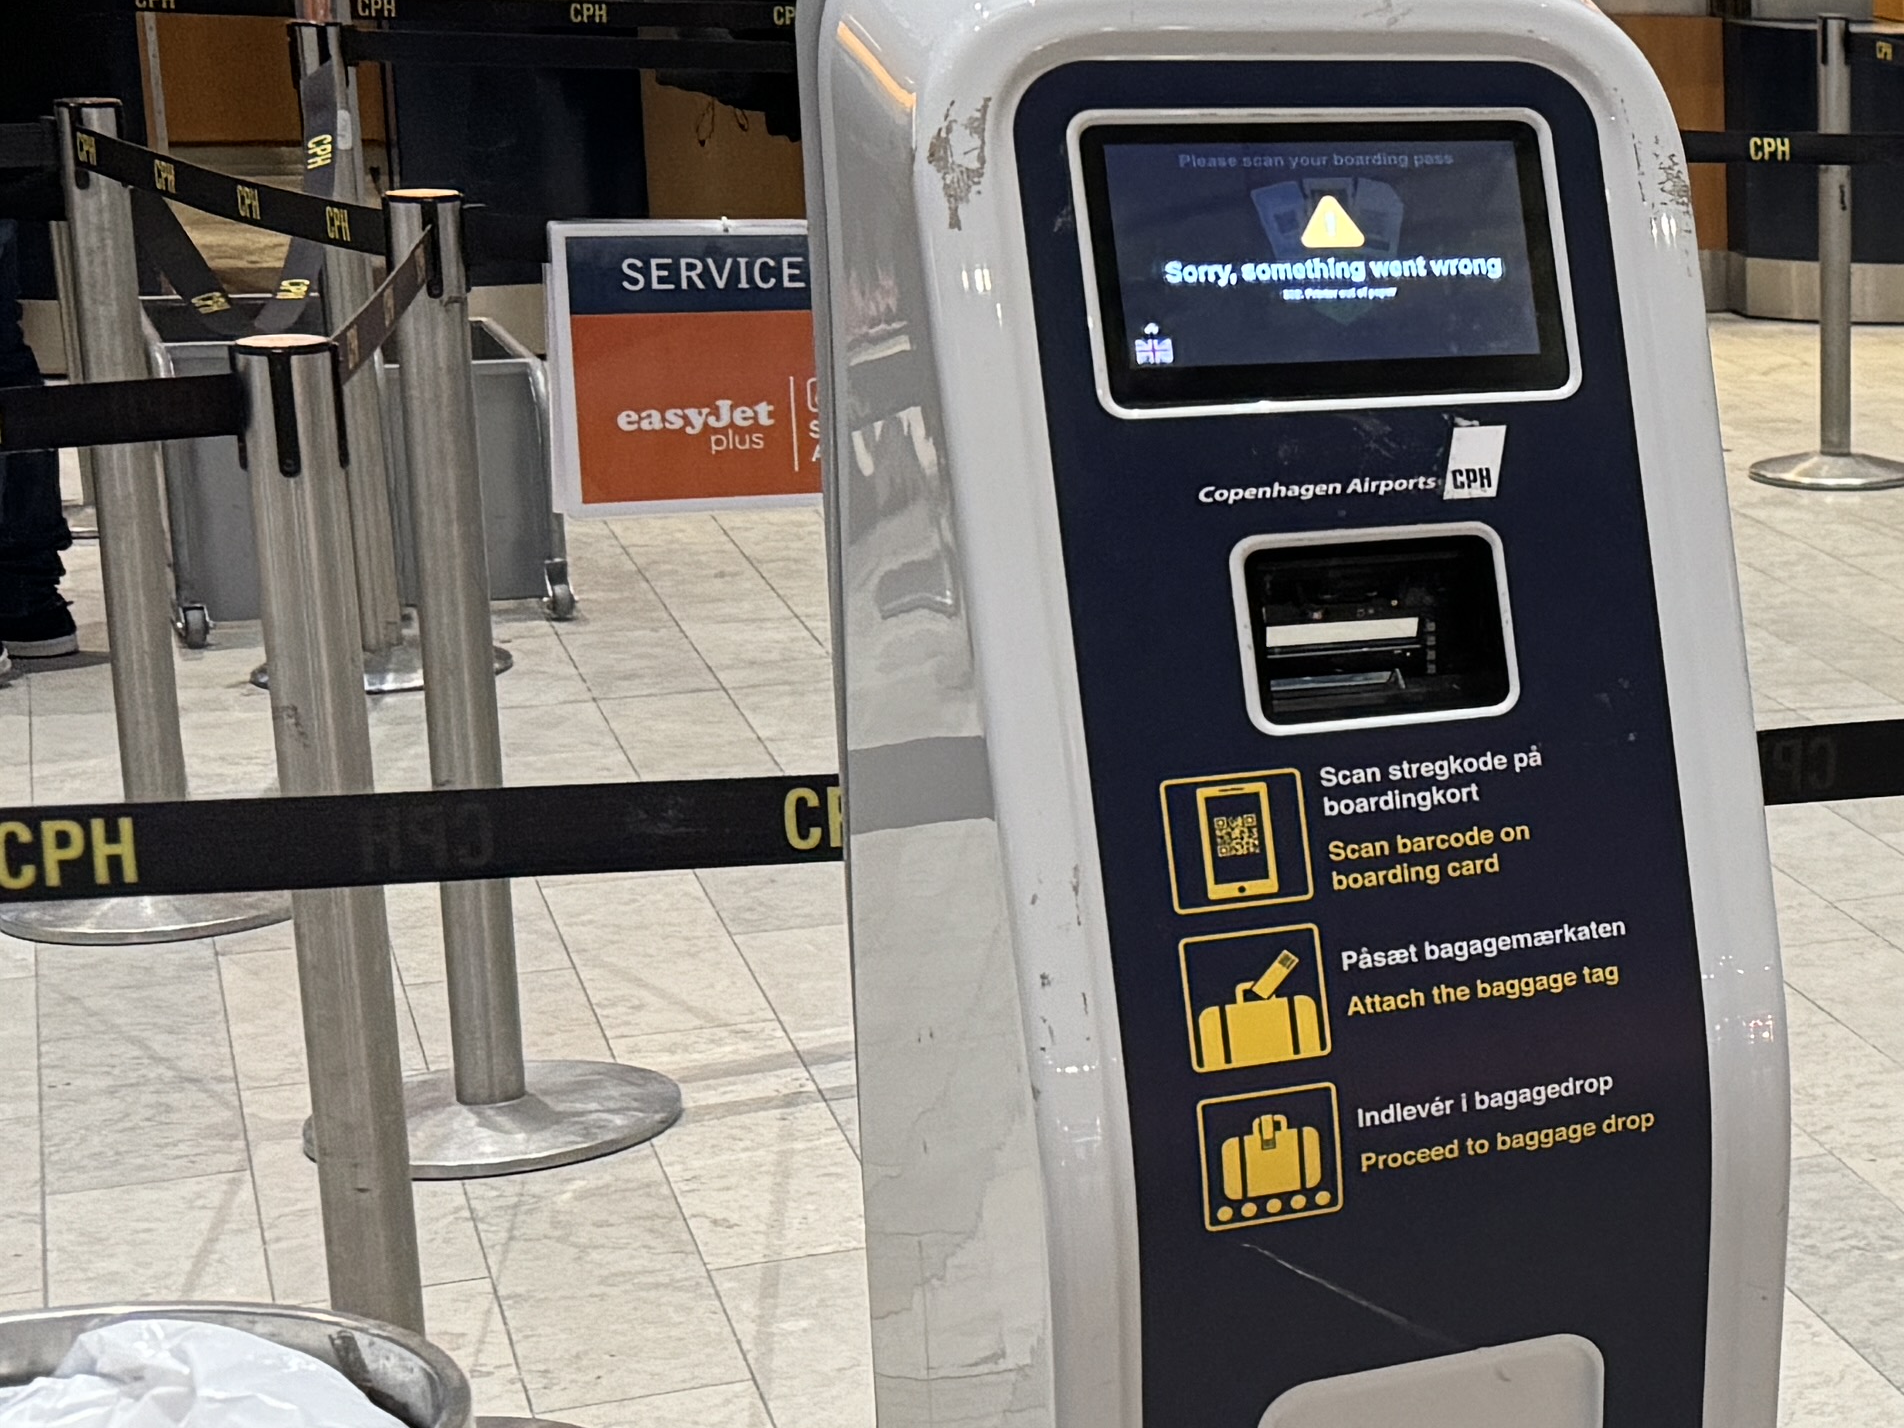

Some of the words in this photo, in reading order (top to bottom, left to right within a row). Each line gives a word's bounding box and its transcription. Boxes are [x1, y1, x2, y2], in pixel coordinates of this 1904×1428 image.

[569, 3, 608, 25] CPH
[306, 133, 333, 170] CPH
[1749, 137, 1790, 162] CPH
[237, 185, 260, 220] CPH
[325, 206, 351, 242] CPH
[621, 257, 806, 291] SERVICE
[1164, 260, 1238, 287] Sorry,
[1241, 256, 1366, 282] something
[1430, 256, 1504, 280] wrong
[616, 399, 775, 435] easyJet
[710, 429, 764, 455] plus
[1198, 478, 1342, 505] Copenhagen
[1346, 474, 1438, 496] Airports
[1451, 466, 1493, 492] CPH
[1319, 763, 1383, 789] Scan
[1387, 751, 1508, 789] stregkode
[1513, 745, 1543, 774] på
[1323, 782, 1480, 818] boardingkort
[0, 816, 139, 892] CPH
[1328, 836, 1390, 863] Scan
[1396, 826, 1494, 854] barcode
[1500, 823, 1531, 844] on
[1331, 860, 1441, 892] boarding
[1446, 852, 1501, 879] card
[1341, 941, 1419, 972] Påsæt
[1423, 918, 1627, 964] bagagemærkaten
[1346, 986, 1426, 1017] Attach
[1431, 979, 1471, 1006] the
[1475, 968, 1578, 1002] baggage
[1582, 962, 1620, 987] tag
[1356, 1093, 1456, 1129] Indlevér
[1473, 1073, 1615, 1112] bagagedrop
[1360, 1139, 1460, 1173] Proceed
[1466, 1133, 1491, 1156] to
[1495, 1118, 1597, 1152] baggage
[1601, 1110, 1656, 1138] drop
